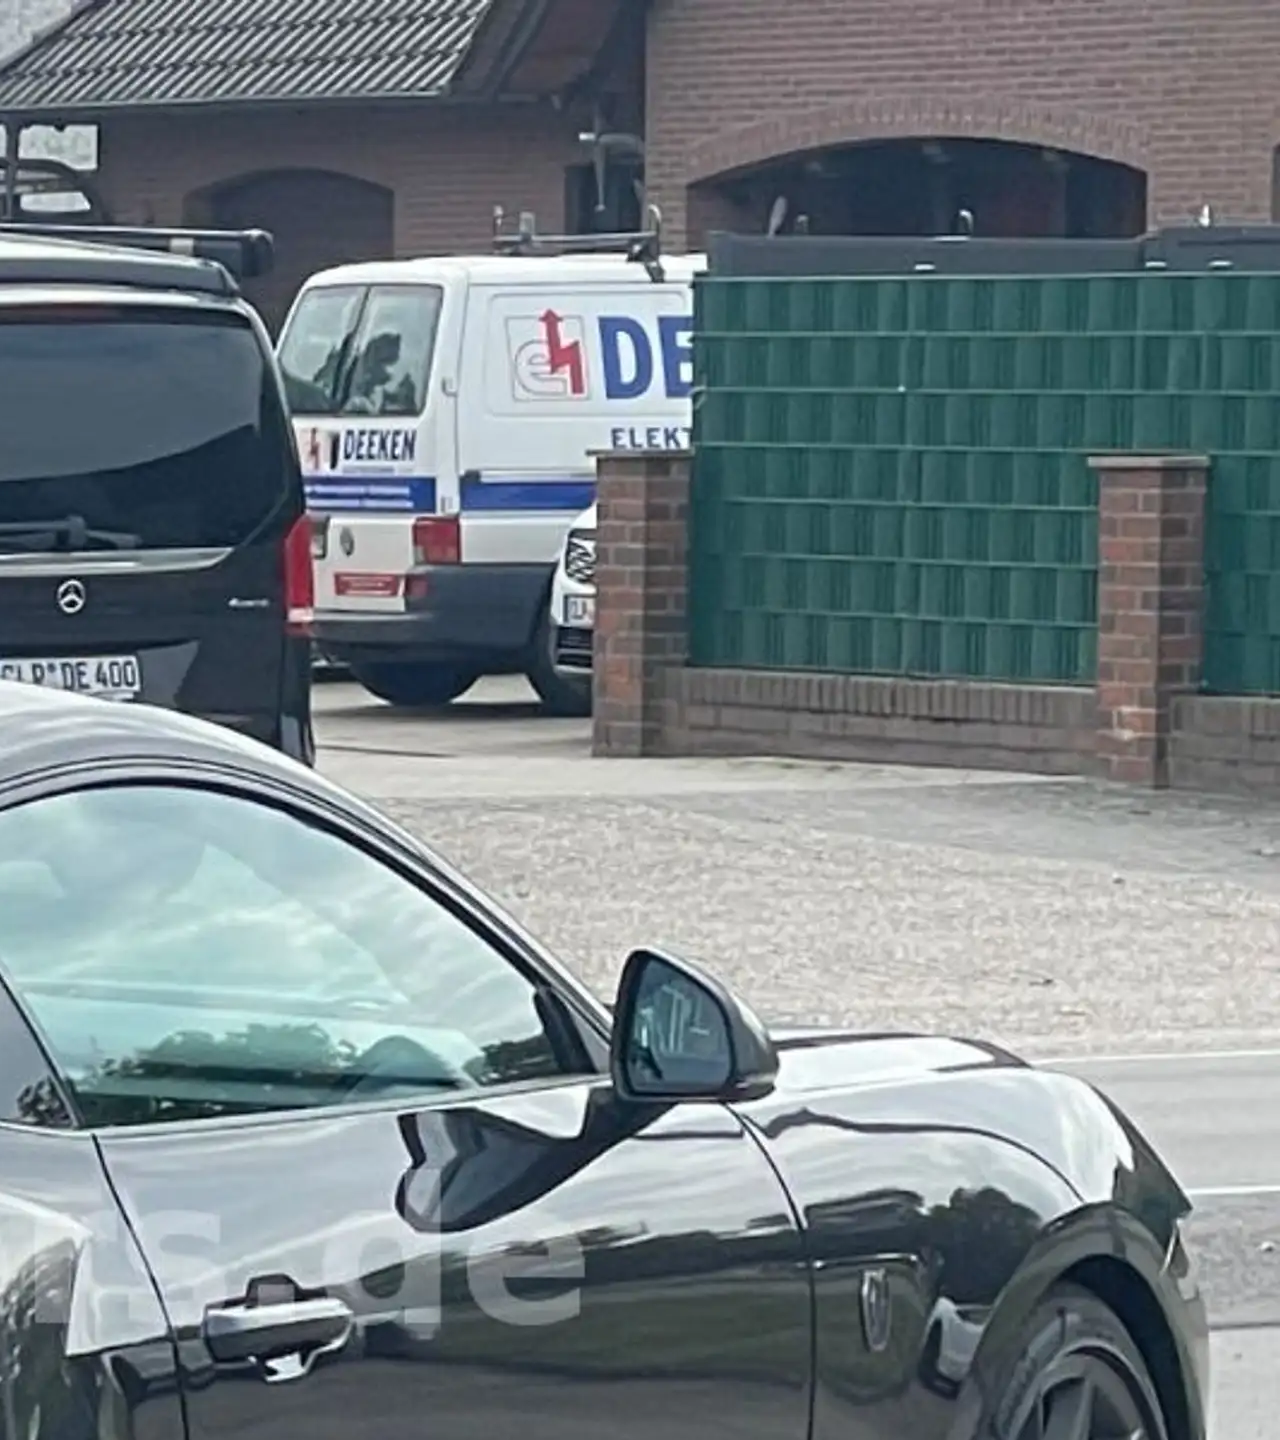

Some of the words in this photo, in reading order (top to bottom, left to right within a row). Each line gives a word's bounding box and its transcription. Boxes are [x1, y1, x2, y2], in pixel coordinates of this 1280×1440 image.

[344, 429, 417, 461] DEEKEN
[60, 661, 91, 691] DE
[96, 660, 137, 688] 400
